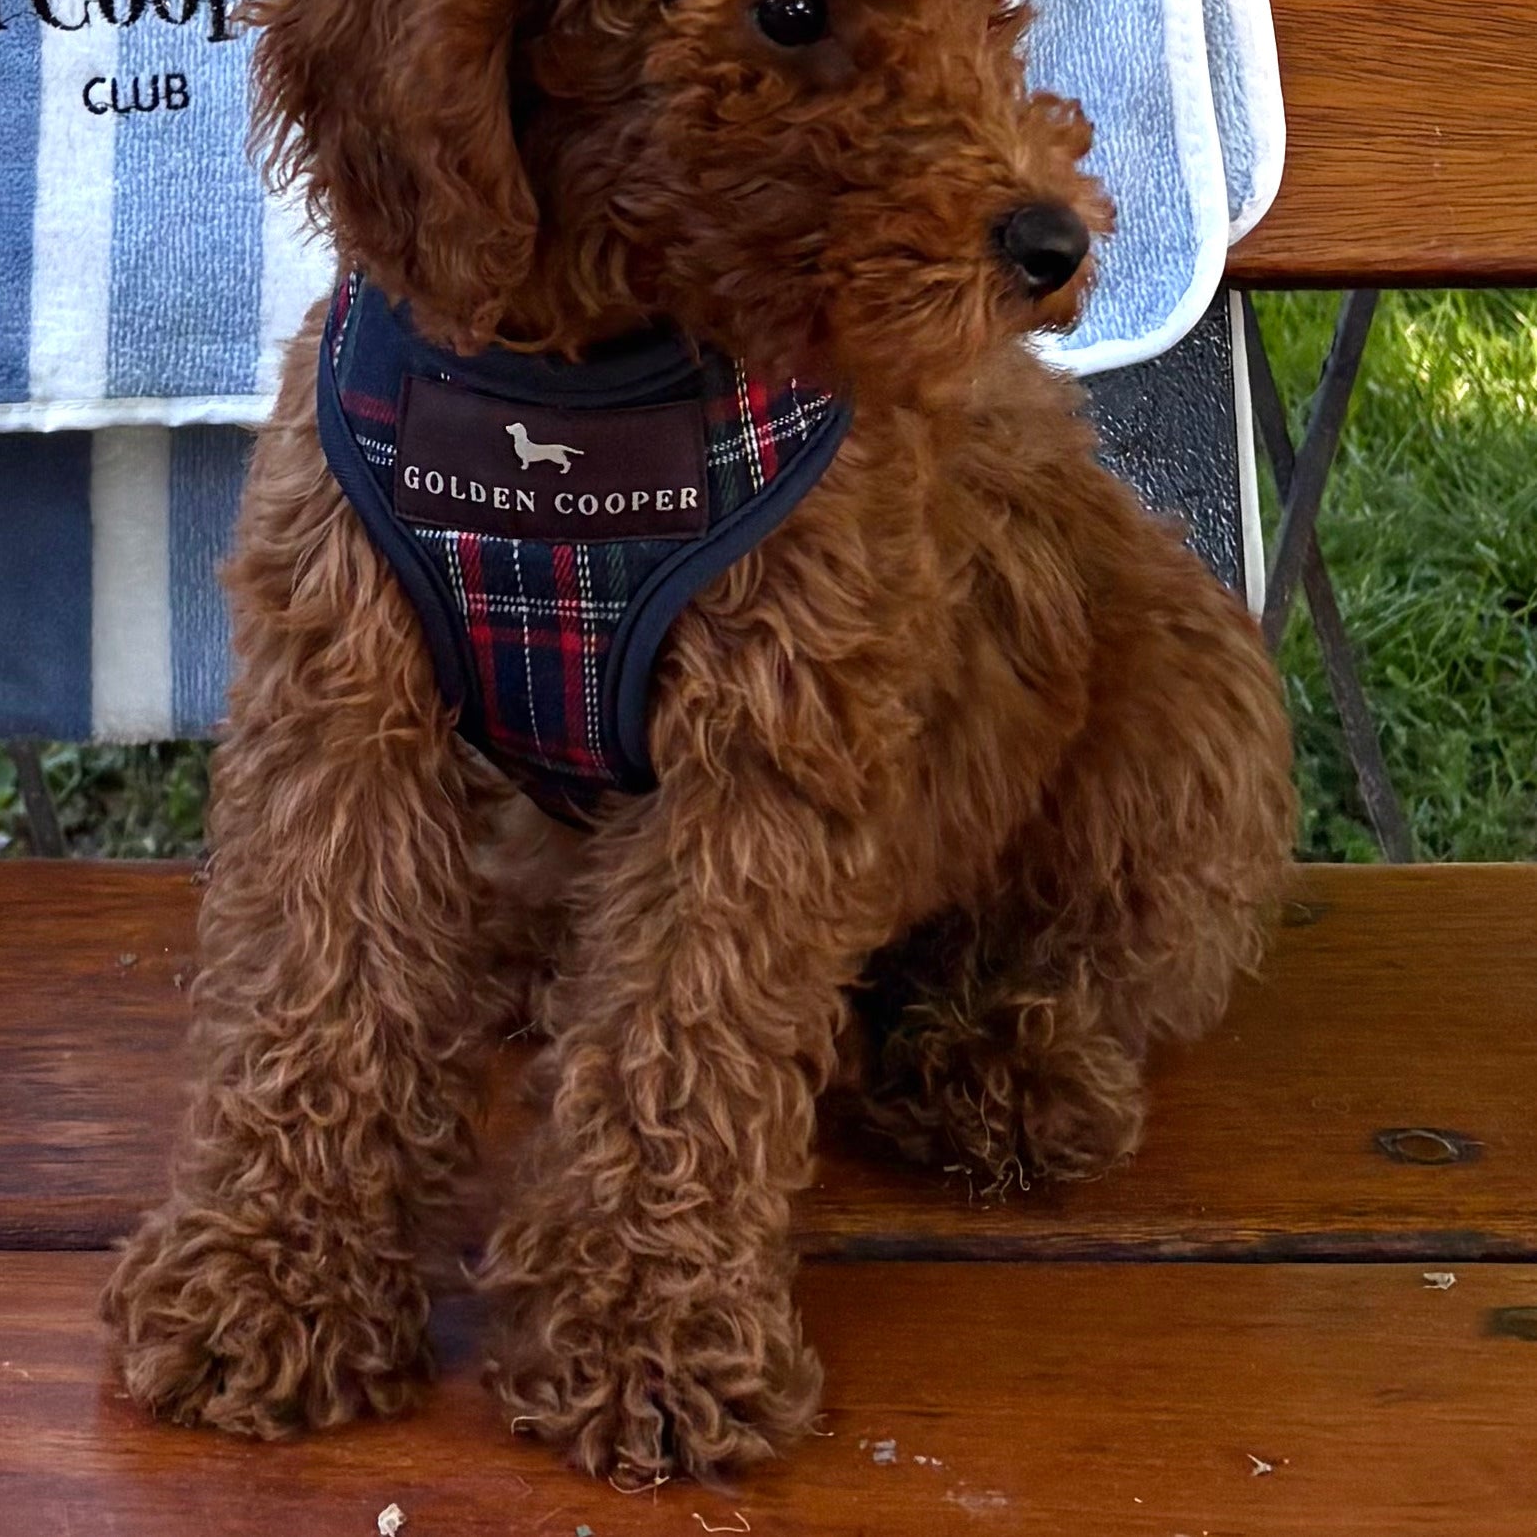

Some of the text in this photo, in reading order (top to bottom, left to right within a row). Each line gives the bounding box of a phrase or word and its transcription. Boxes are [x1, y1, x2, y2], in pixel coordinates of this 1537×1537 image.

[81, 73, 191, 115] CLUB
[403, 465, 698, 515] GOLDEN COOPER
